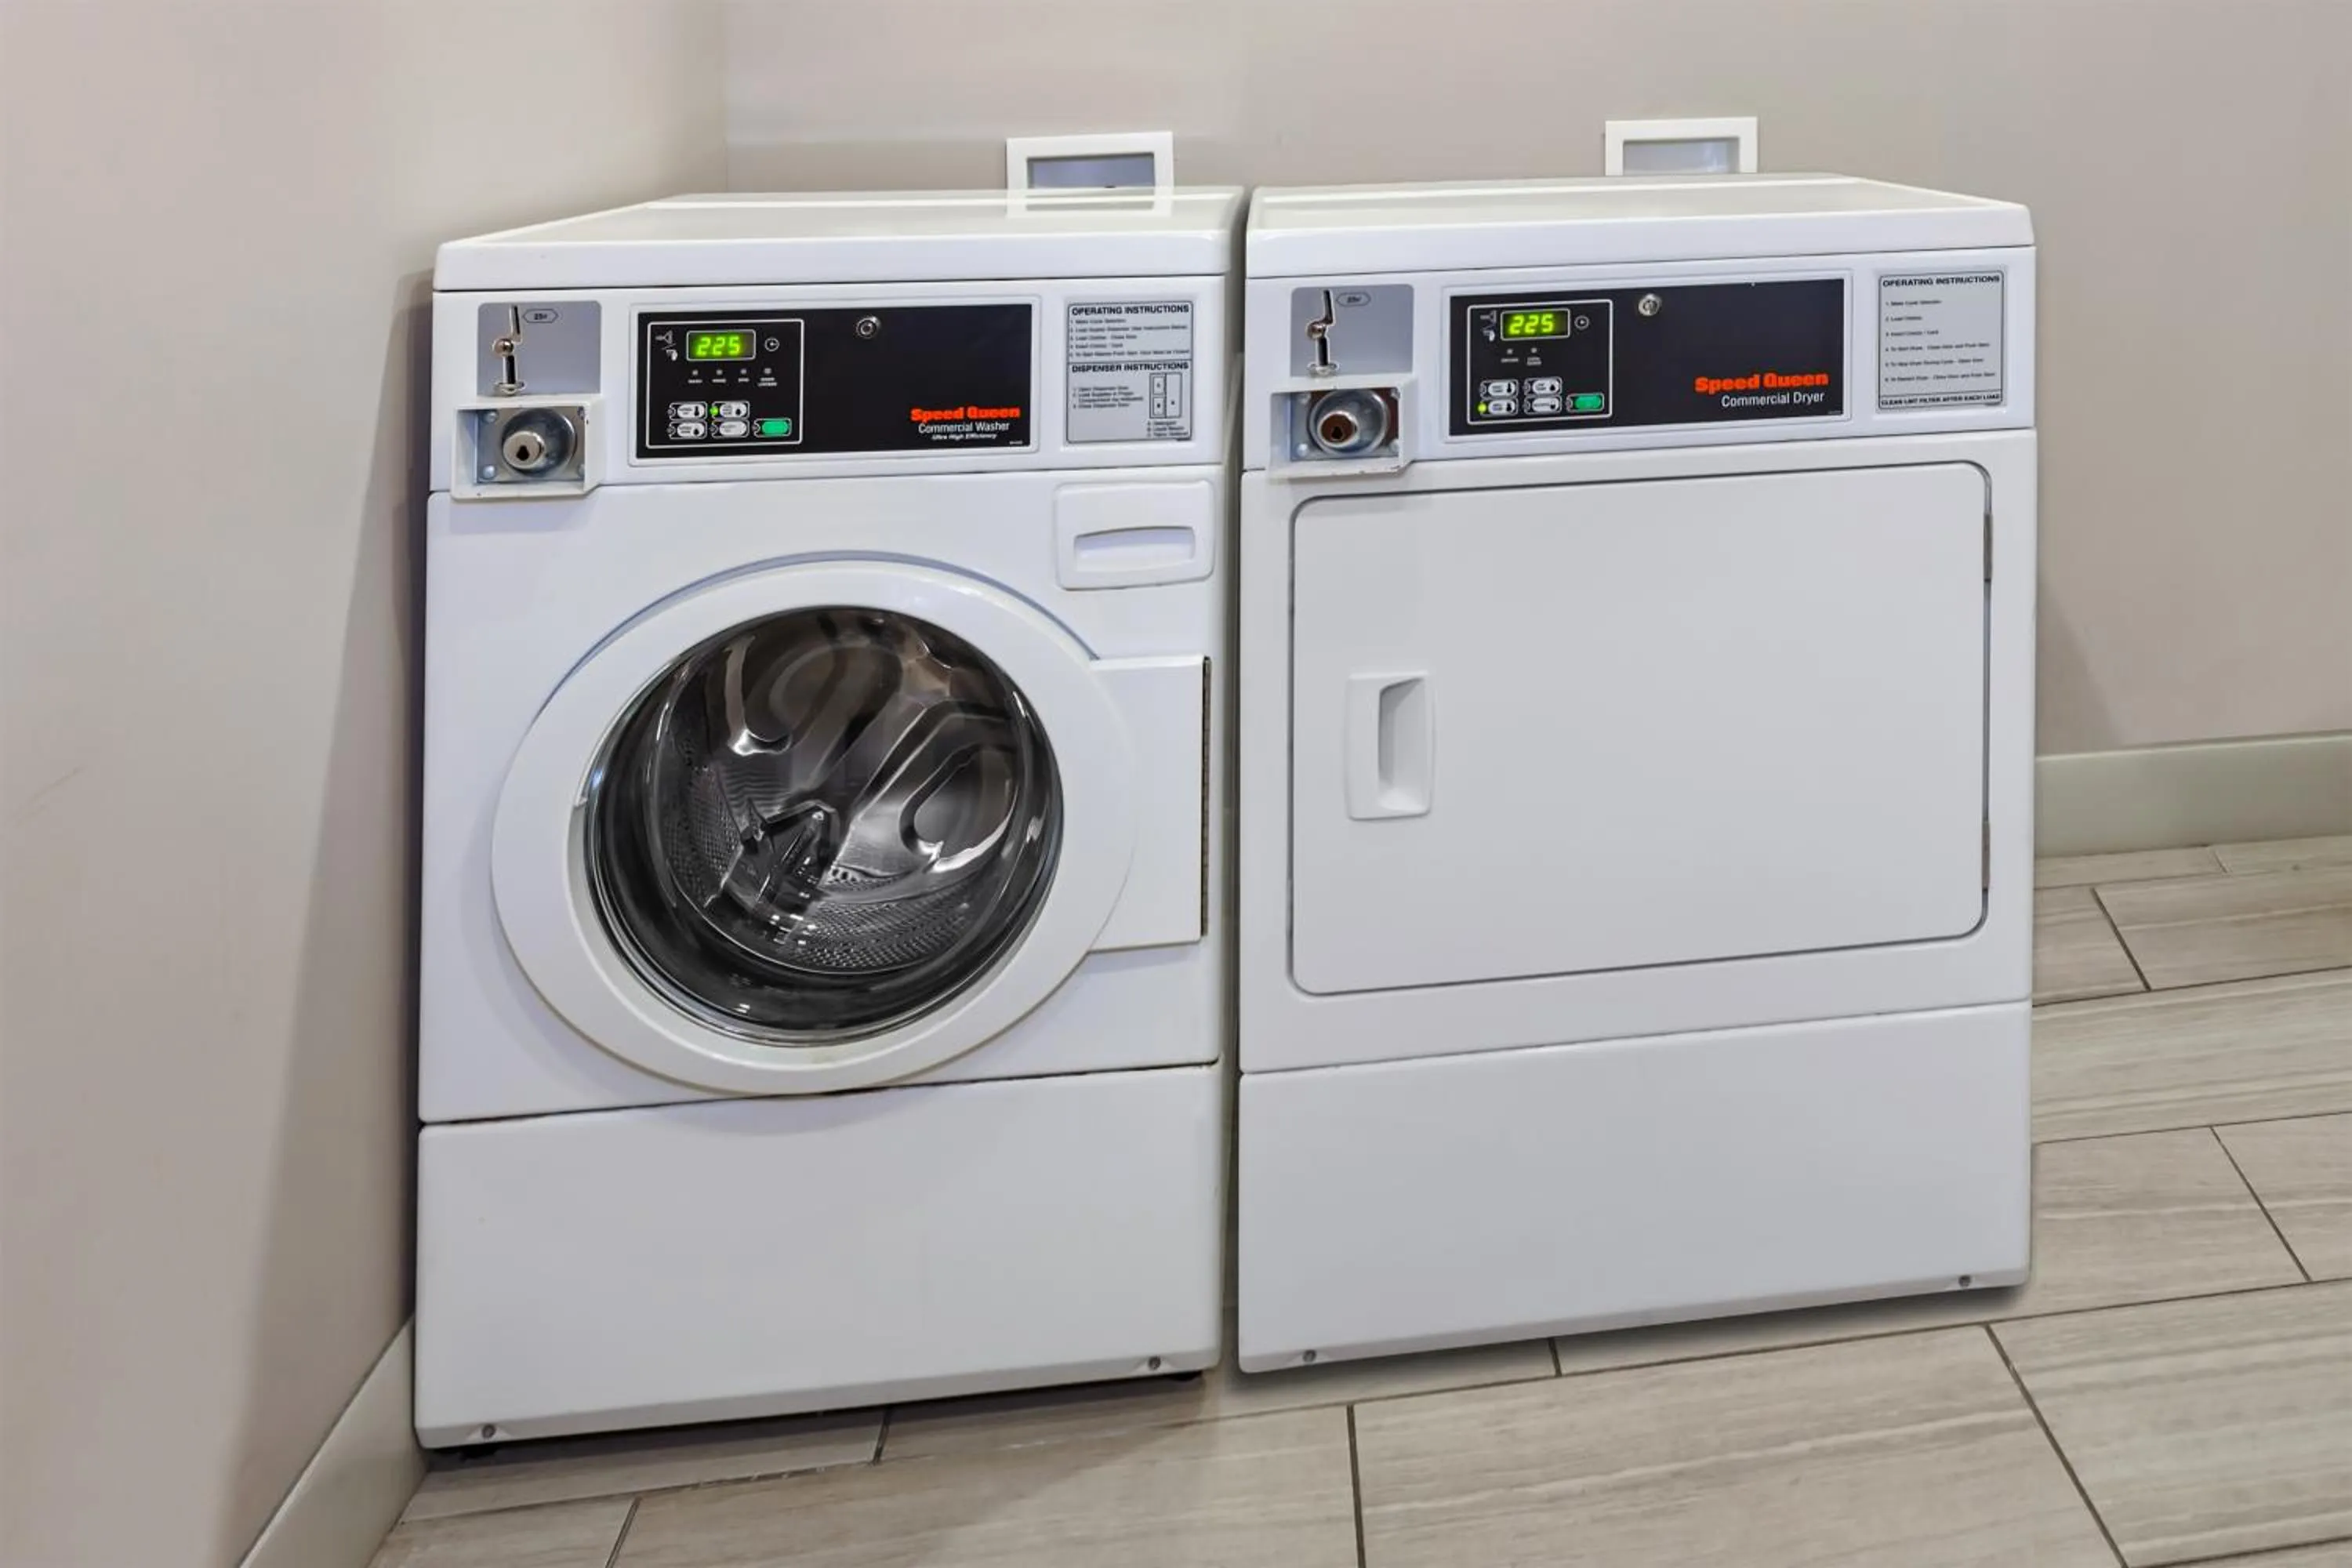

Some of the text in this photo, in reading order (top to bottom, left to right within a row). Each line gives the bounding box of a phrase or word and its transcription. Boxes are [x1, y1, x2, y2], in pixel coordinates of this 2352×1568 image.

[1882, 275, 2000, 287] OPERATING INSTRUCTIONS
[1072, 304, 1189, 316] OPERATING INSTRUCTIONS
[1508, 314, 1555, 335] 225
[696, 336, 741, 357] 225
[1072, 362, 1189, 373] DISPENSER INSTRUCTIONS
[1695, 372, 1829, 394] Speed Queen
[1721, 392, 1825, 407] Commercial Dryer
[911, 406, 1021, 423] Speed Queen
[918, 421, 1010, 434] Commercial Washer
